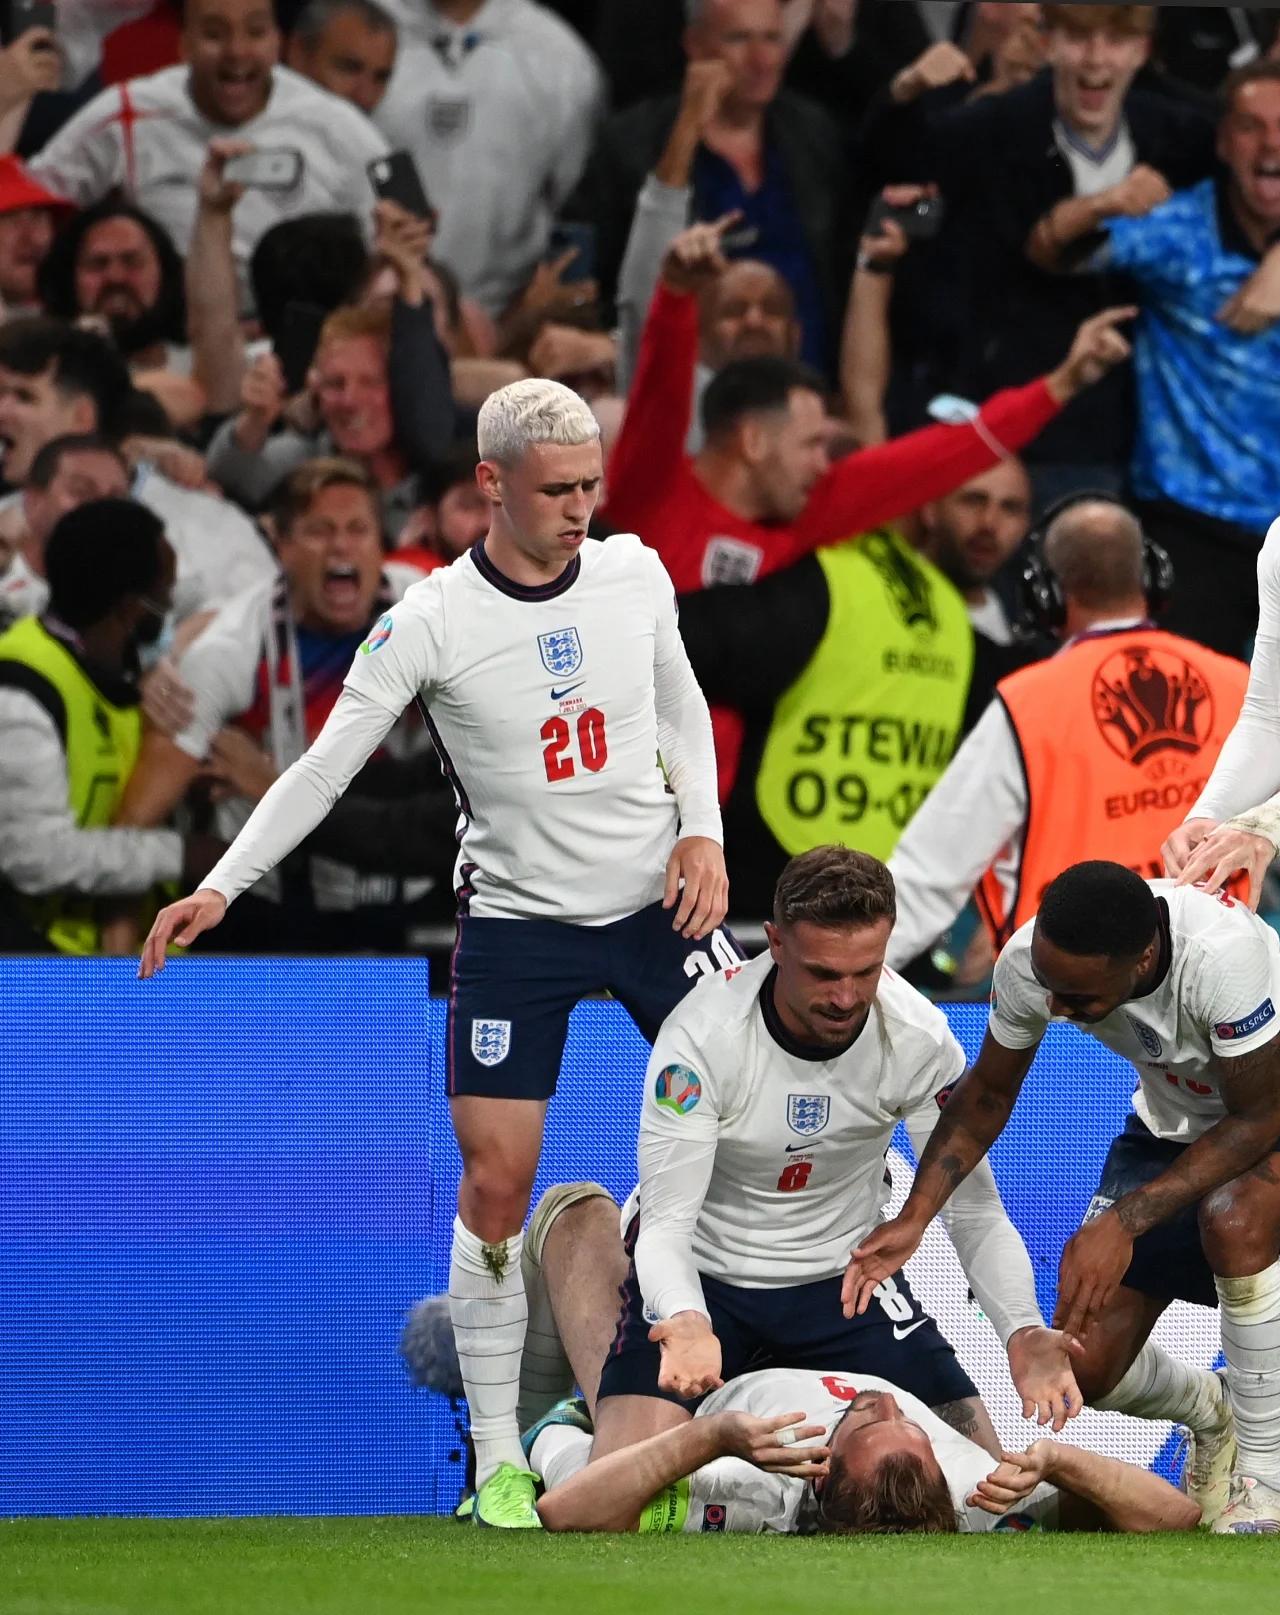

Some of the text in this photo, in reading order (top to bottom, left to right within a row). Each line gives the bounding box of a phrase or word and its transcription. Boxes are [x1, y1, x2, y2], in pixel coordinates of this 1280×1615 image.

[539, 707, 607, 783] 20
[1235, 1003, 1273, 1034] RESPECT
[872, 1276, 914, 1322] 8
